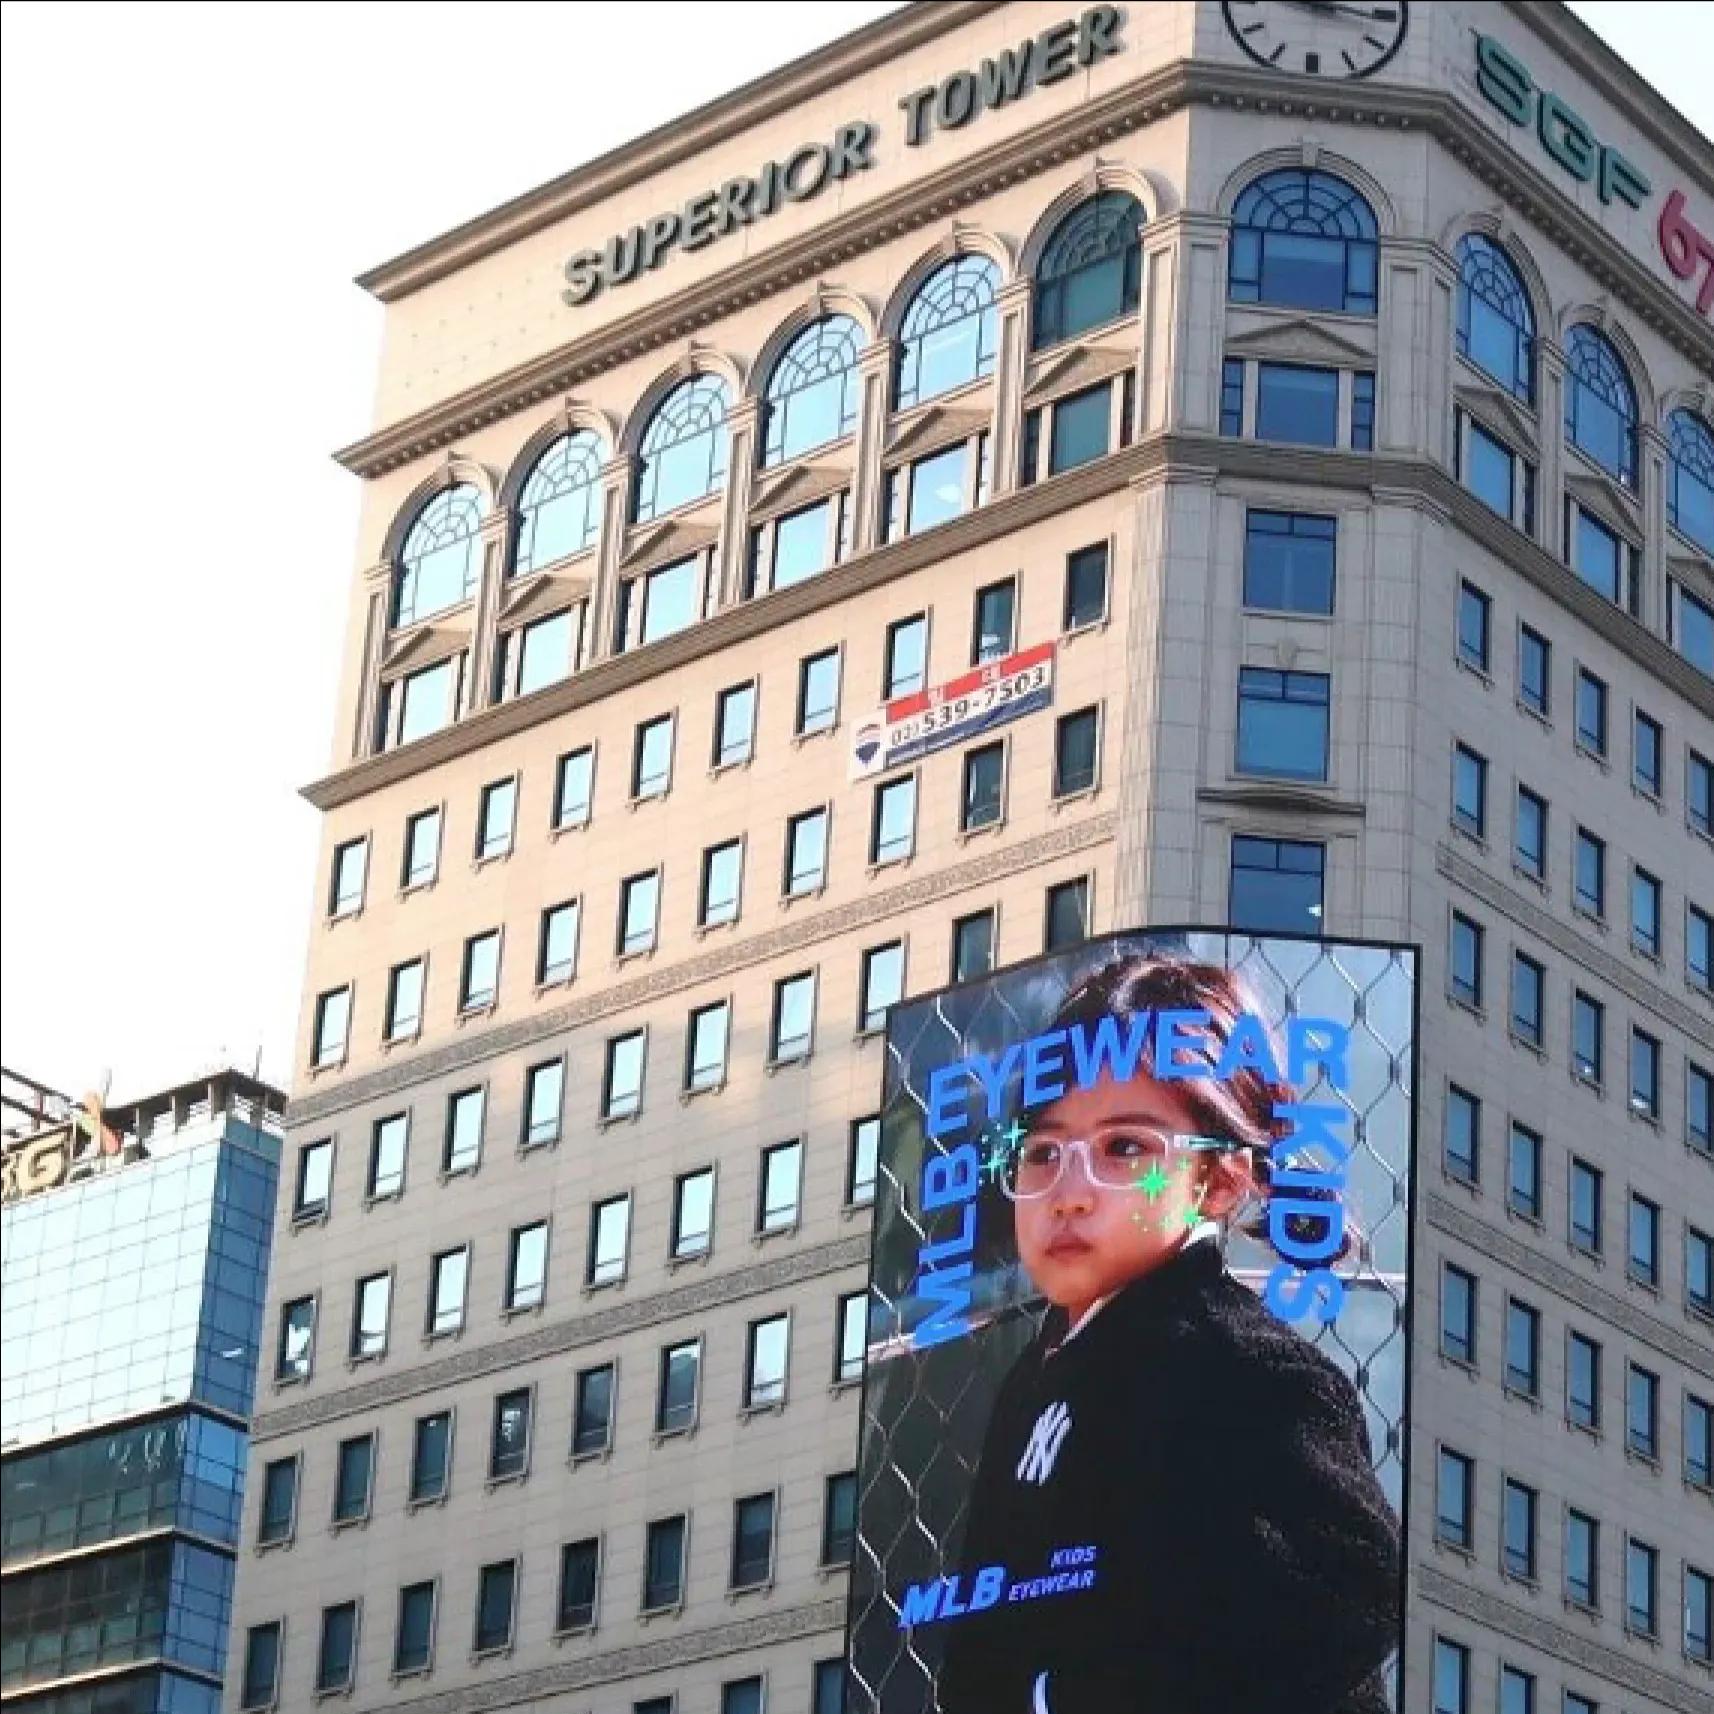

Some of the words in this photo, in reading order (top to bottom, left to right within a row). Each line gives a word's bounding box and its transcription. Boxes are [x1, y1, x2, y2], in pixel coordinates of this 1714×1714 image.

[561, 119, 873, 306] SUPERIOR
[897, 4, 1126, 146] TOWER
[1474, 32, 1652, 210] SGF
[924, 1008, 1352, 1136] EYEWEAR
[912, 1141, 980, 1349] MLB
[1262, 1100, 1350, 1327] KIDS
[898, 1565, 1007, 1628] MLB
[1007, 1569, 1096, 1602] EYEWEAR
[1049, 1544, 1098, 1569] KIDS
